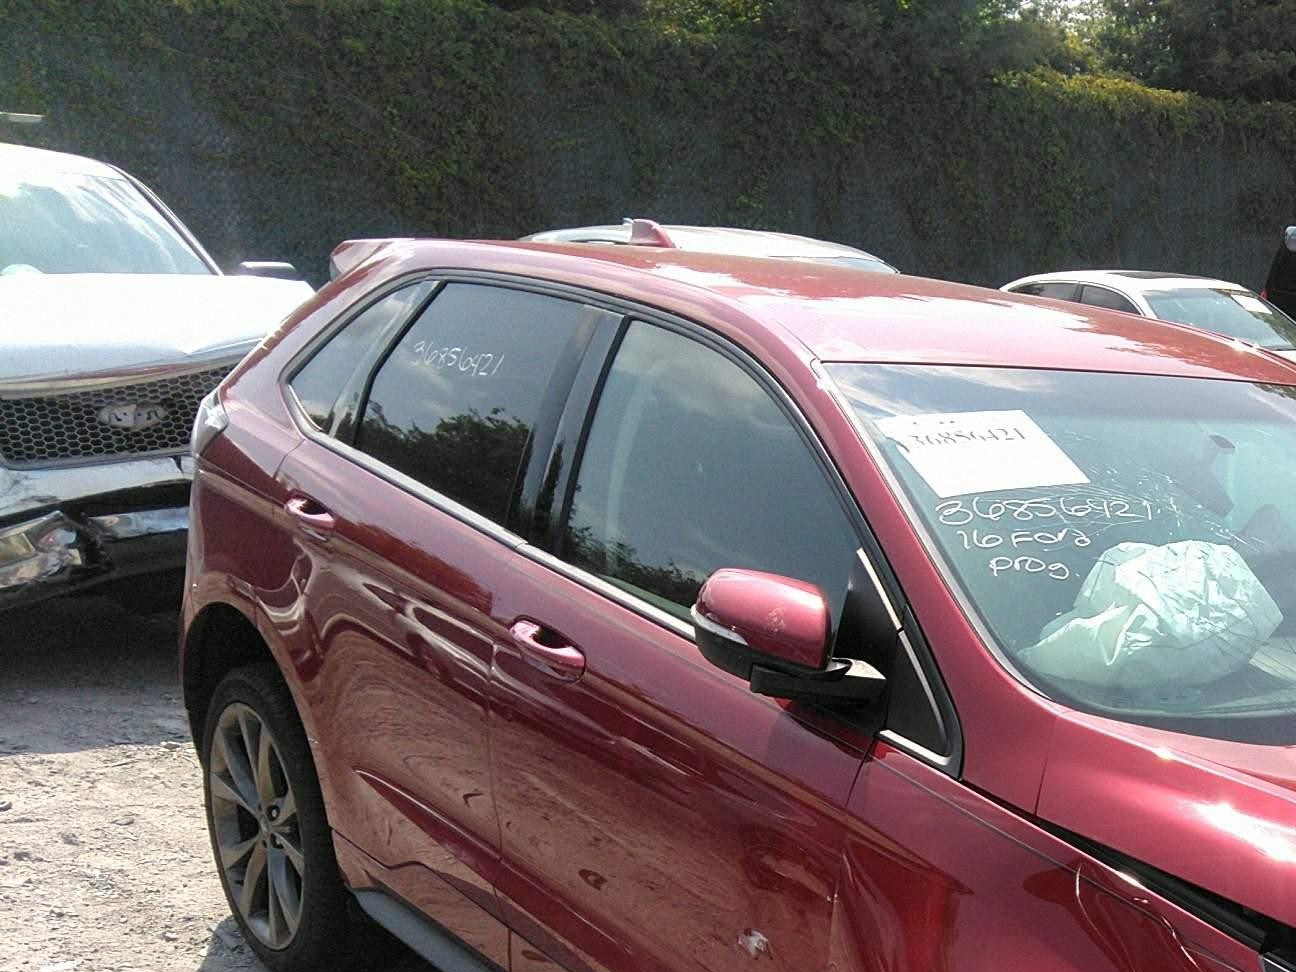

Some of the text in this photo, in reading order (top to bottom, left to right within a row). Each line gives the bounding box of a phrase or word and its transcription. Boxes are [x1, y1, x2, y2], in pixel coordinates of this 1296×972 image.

[411, 340, 505, 376] 36856421
[935, 496, 1154, 526] 36856421
[956, 529, 1003, 549] 16
